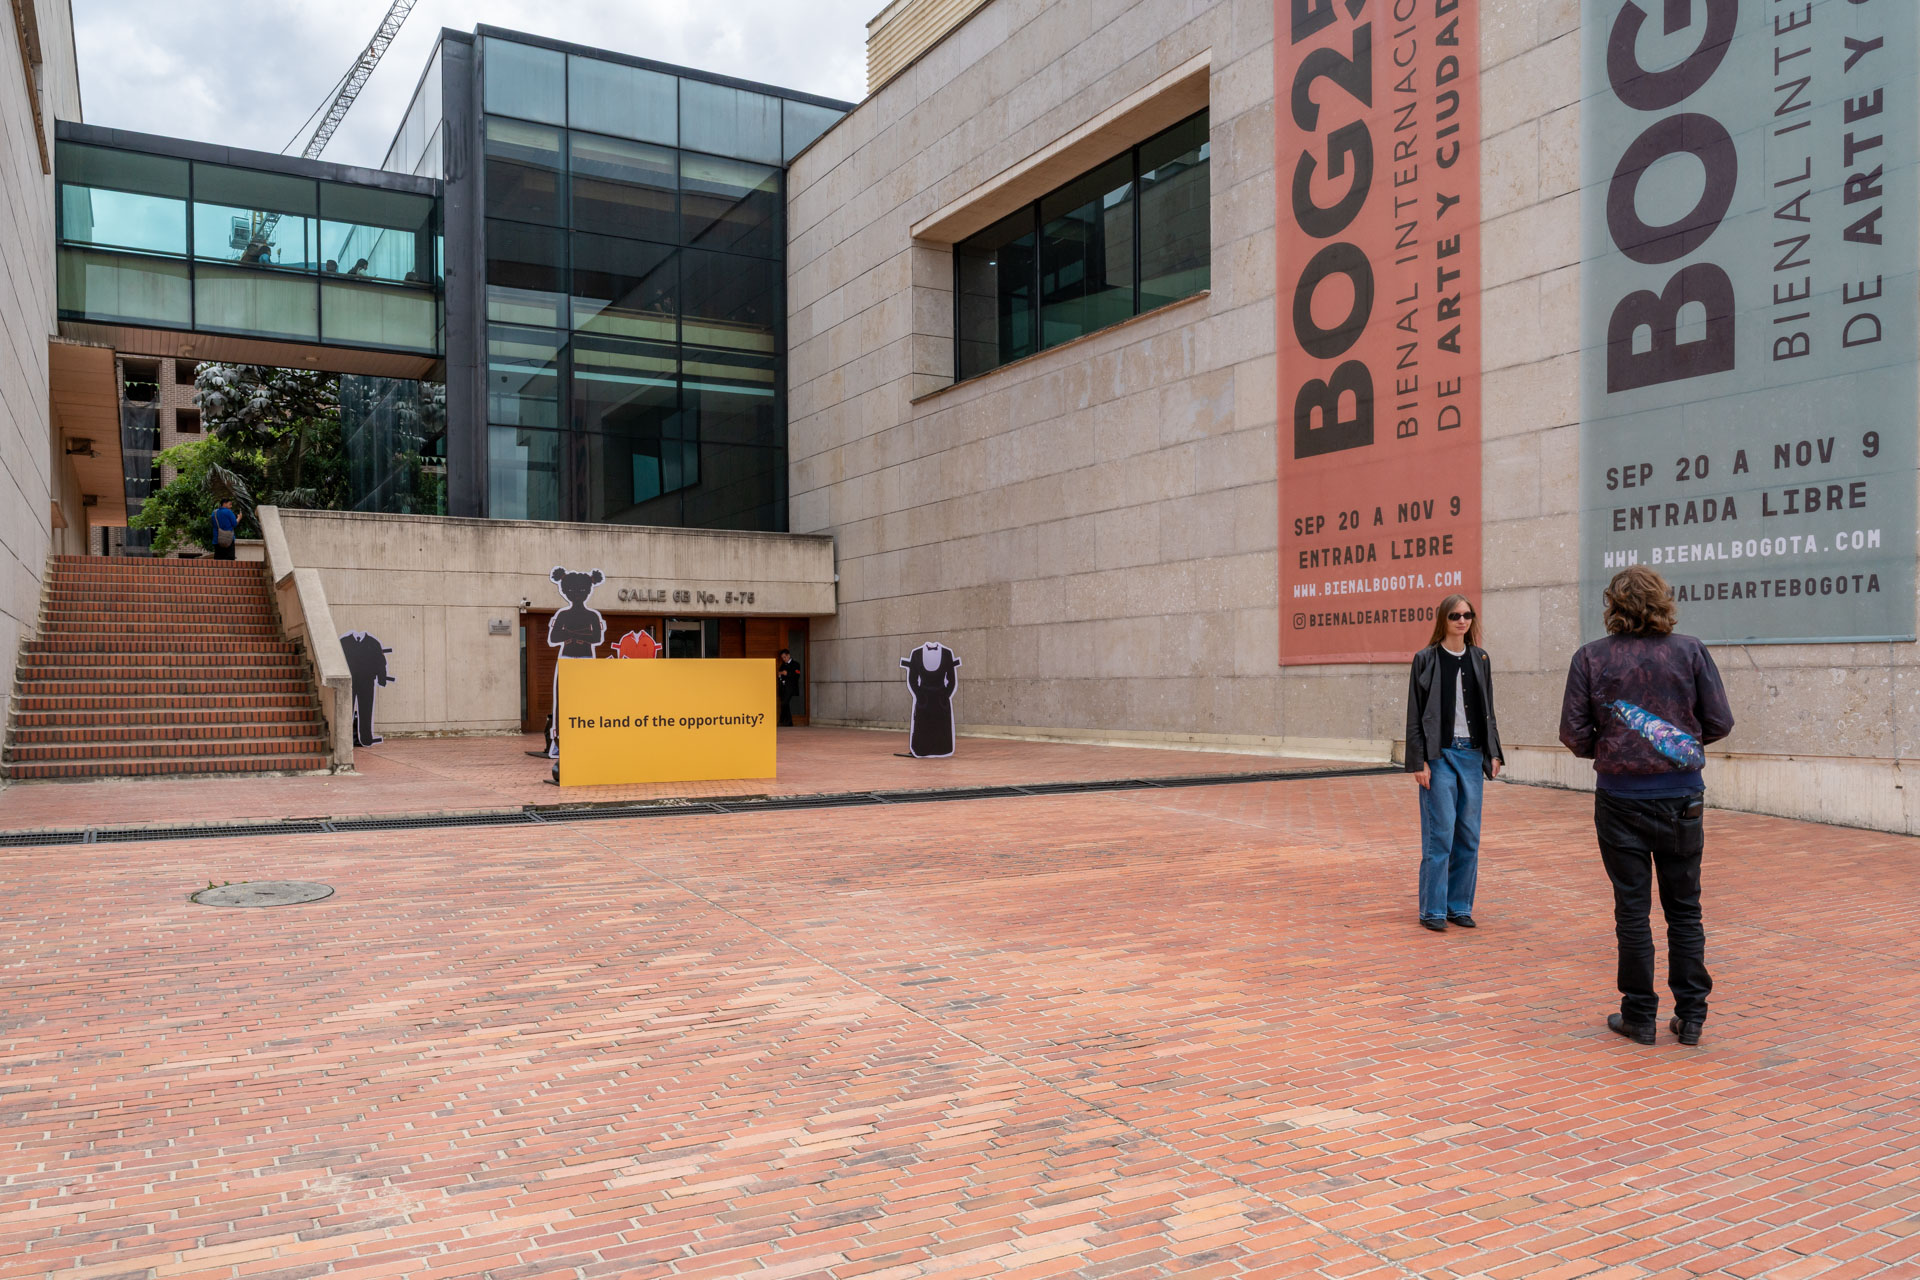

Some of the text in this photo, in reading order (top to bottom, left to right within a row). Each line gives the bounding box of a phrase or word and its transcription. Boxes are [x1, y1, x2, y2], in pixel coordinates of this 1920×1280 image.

[1843, 35, 1884, 74] Y
[1772, 0, 1812, 362] BIENAL INTE
[1843, 87, 1884, 246] ARTE
[1436, 192, 1460, 221] Y
[1606, 0, 1739, 395] BOG
[1436, 233, 1461, 355] ARTE
[1842, 274, 1883, 349] DE
[1396, 282, 1419, 440] BIENAL
[1437, 376, 1461, 432] DE
[1606, 430, 1880, 491] SEP 20 A NOV 9
[1294, 495, 1461, 537] SEP 20 A NOV 9
[1613, 481, 1867, 532] ENTRADA LIBRE
[1299, 534, 1453, 570] ENTRADA LIBRE
[1604, 528, 1881, 569] WWW.BIENALBOGOTA.COM
[617, 588, 666, 604] CALLE
[696, 590, 719, 605] No.
[1293, 570, 1463, 598] WWW.BIENALBOGOTA.COM
[1665, 573, 1881, 604] ALDEARTEBOGOTA
[1309, 607, 1440, 628] BIENALDEARTEBOG
[568, 713, 765, 730] The land of the opportunity?
